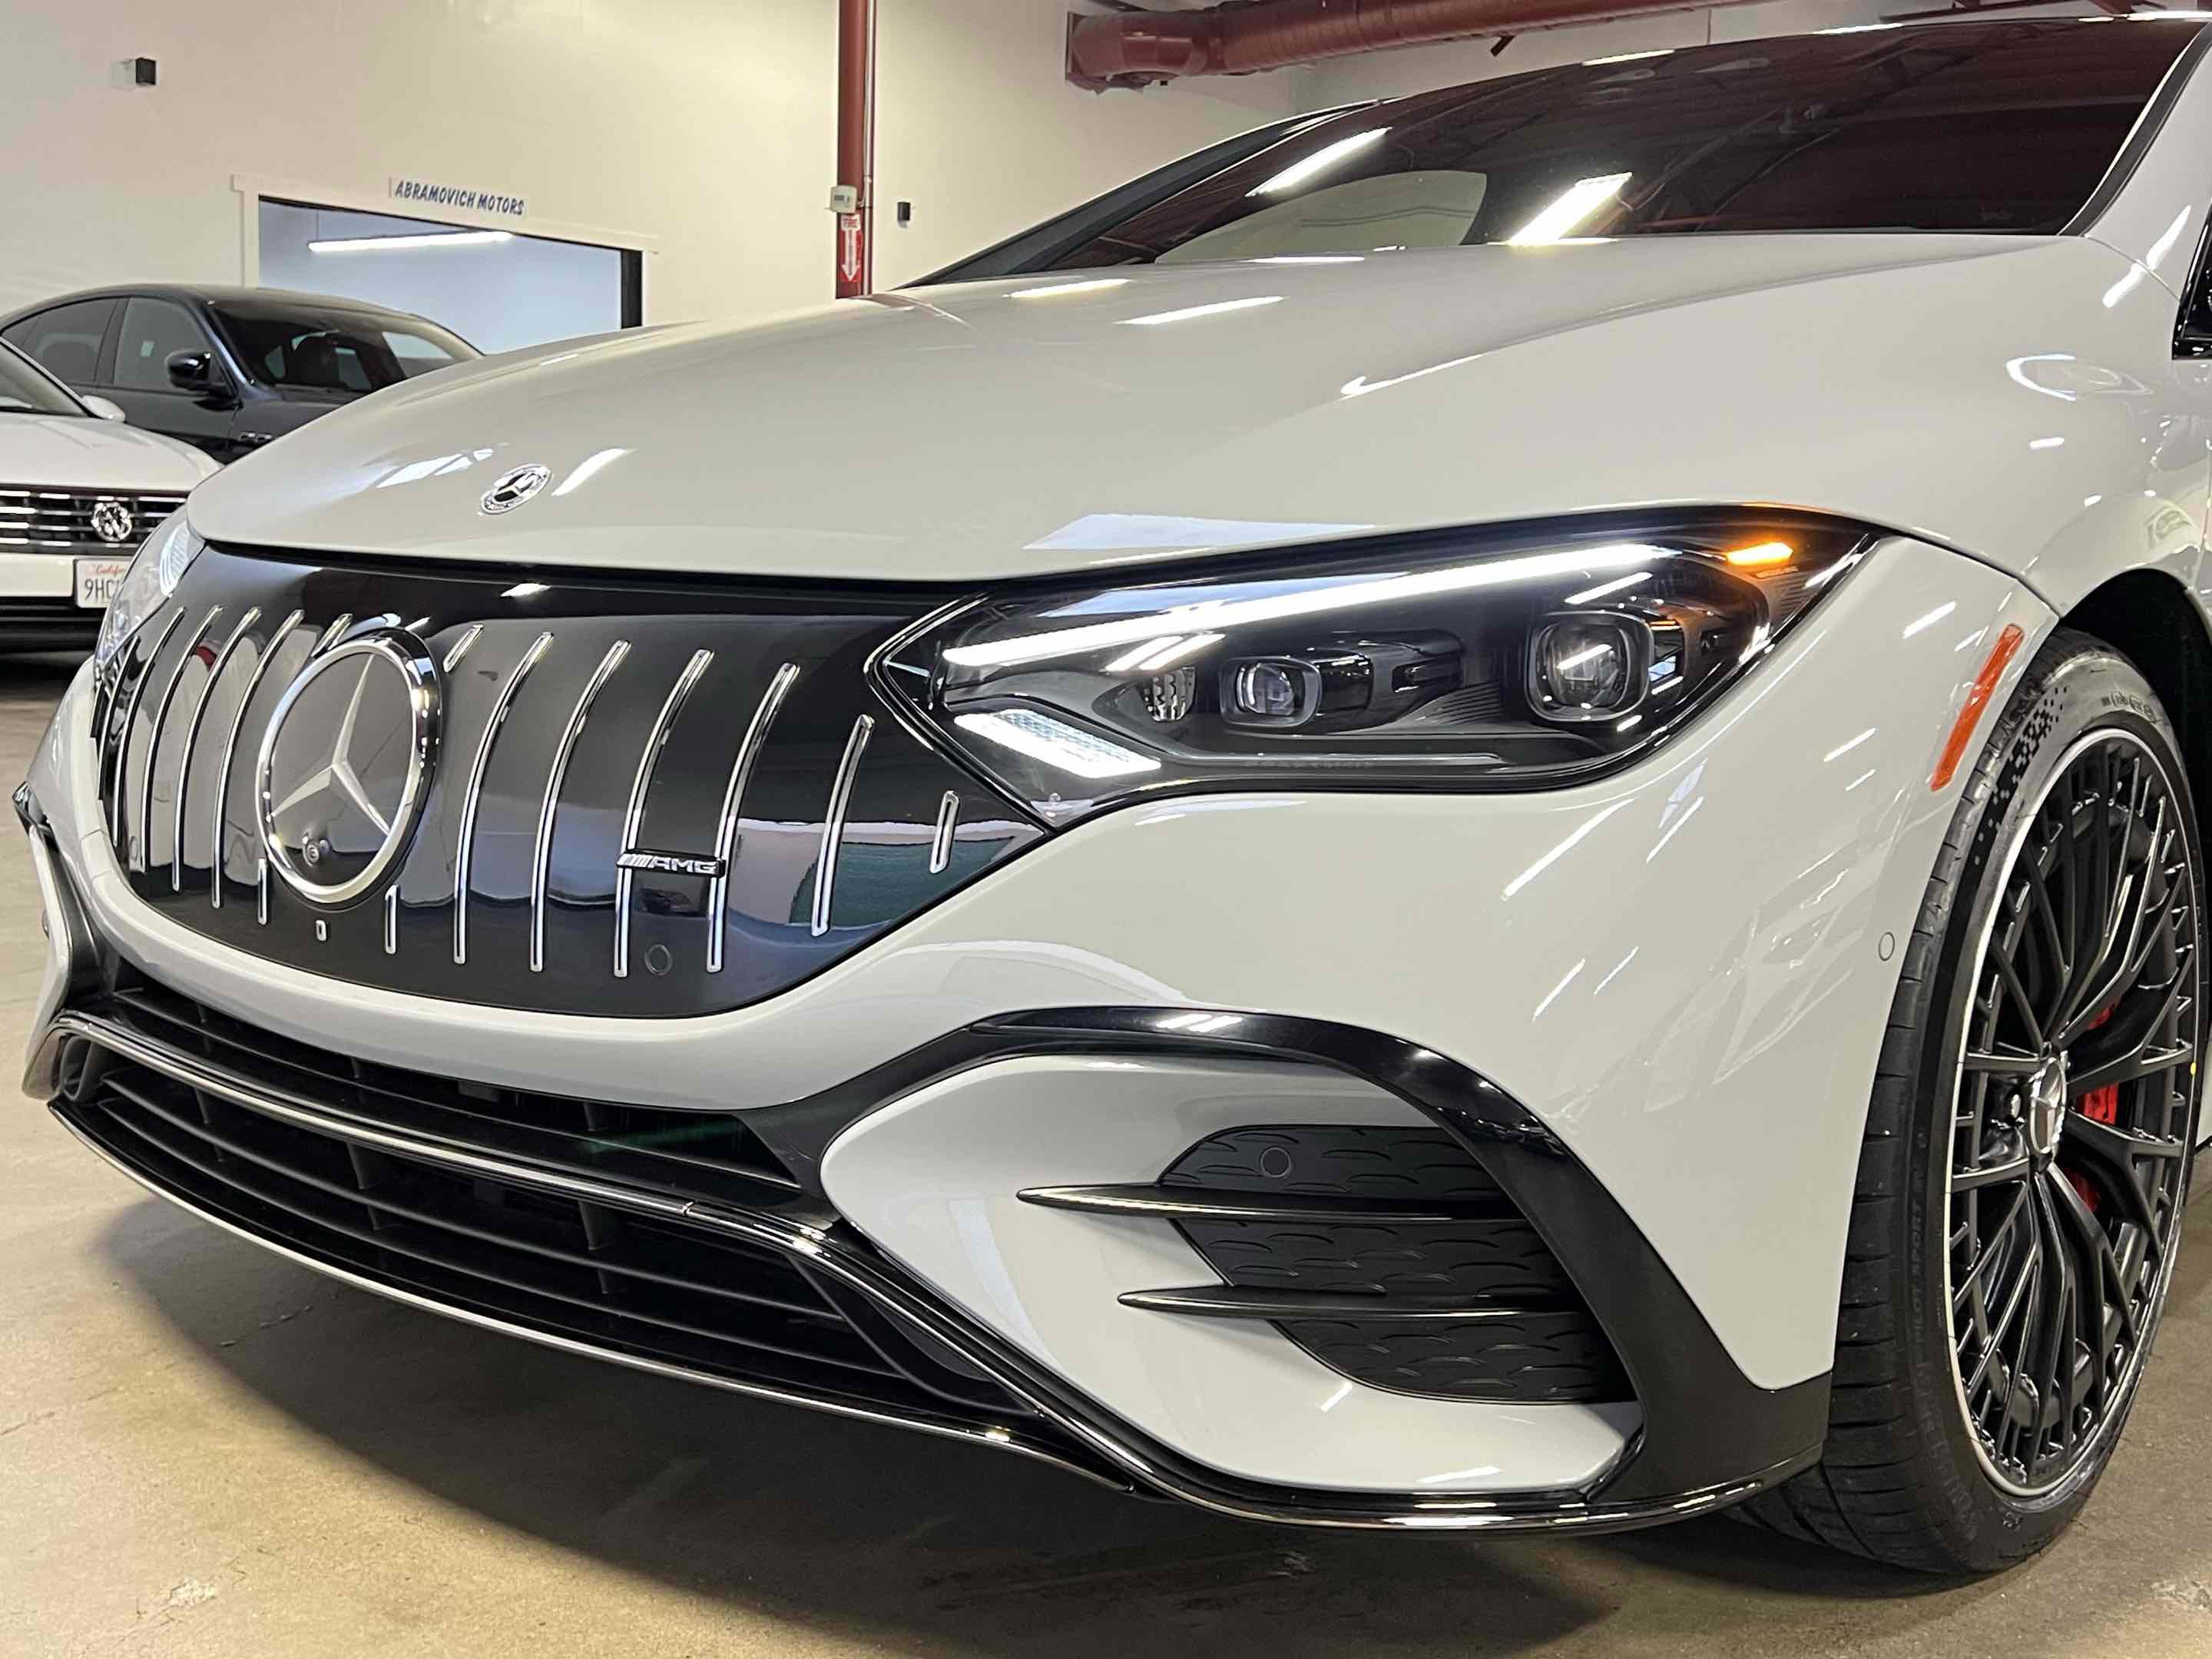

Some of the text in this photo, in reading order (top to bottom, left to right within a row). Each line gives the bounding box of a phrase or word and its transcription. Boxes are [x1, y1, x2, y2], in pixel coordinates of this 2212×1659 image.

[395, 180, 524, 216] ABRAMOVICH MOTORS
[84, 578, 121, 601] 9HC
[647, 856, 718, 875] AMG
